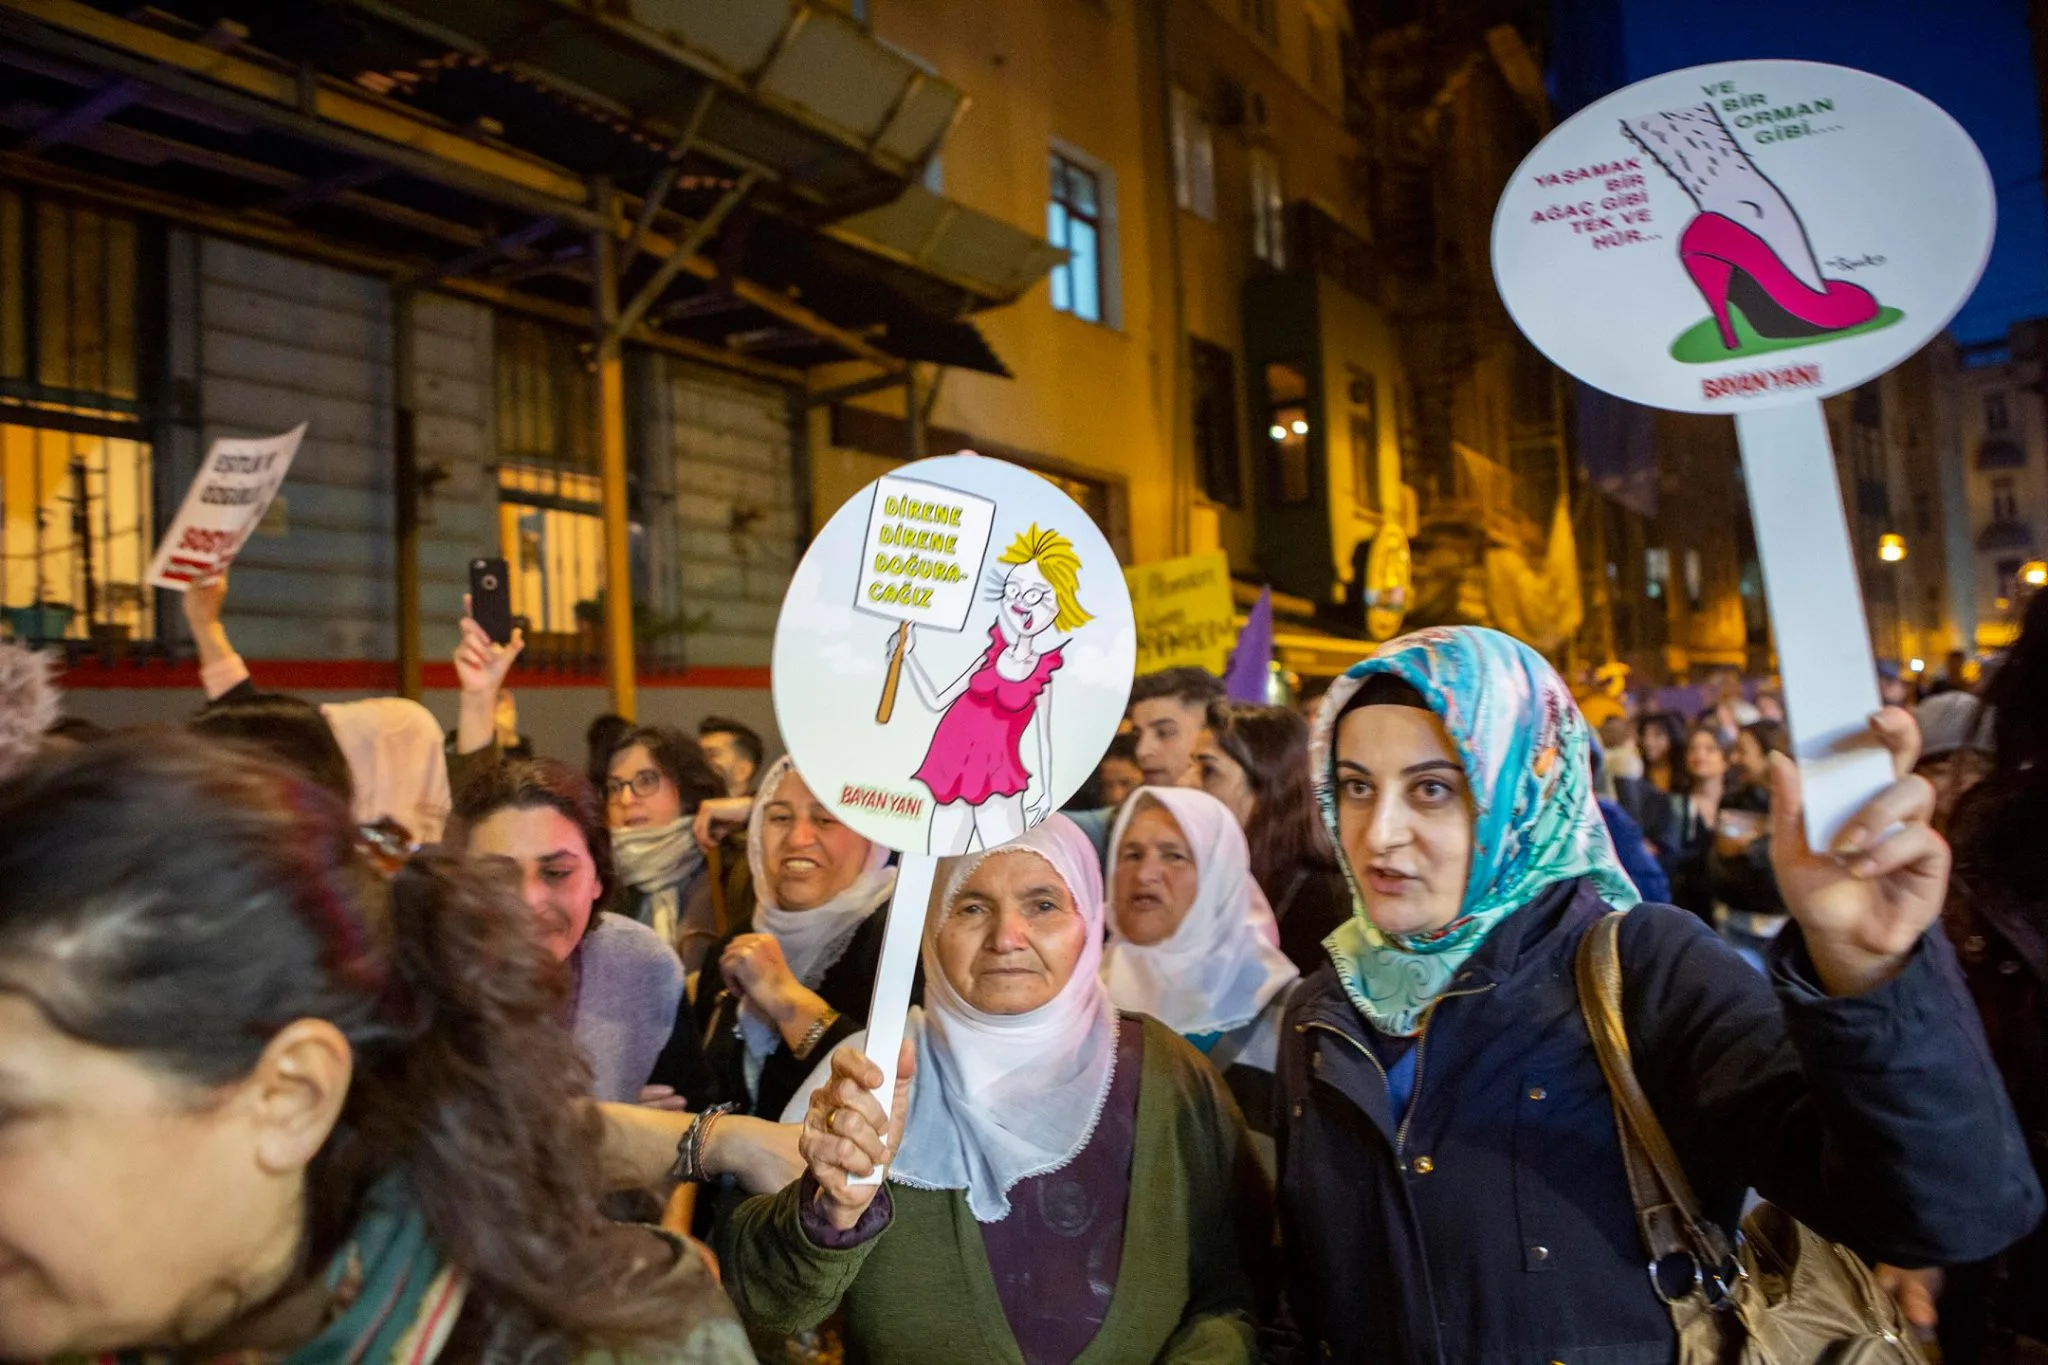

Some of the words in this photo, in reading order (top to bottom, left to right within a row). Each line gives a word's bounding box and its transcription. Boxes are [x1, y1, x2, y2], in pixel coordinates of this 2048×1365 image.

[1700, 80, 1736, 97] VE
[1721, 93, 1767, 112] BİR
[1734, 98, 1834, 128] ORMAN
[1533, 157, 1641, 187] YAŞAMAK
[1605, 174, 1645, 191] BİR
[1531, 201, 1594, 223] AĞAÇ
[1601, 188, 1648, 210] GİBİ
[1569, 217, 1615, 233] TEK
[1619, 208, 1652, 224] VE
[884, 494, 963, 527] DİRENE
[879, 523, 958, 556] DİRENE
[874, 552, 968, 583] DOĞURA-
[868, 581, 935, 608] CAĞIZ
[840, 784, 889, 810] BAYAN
